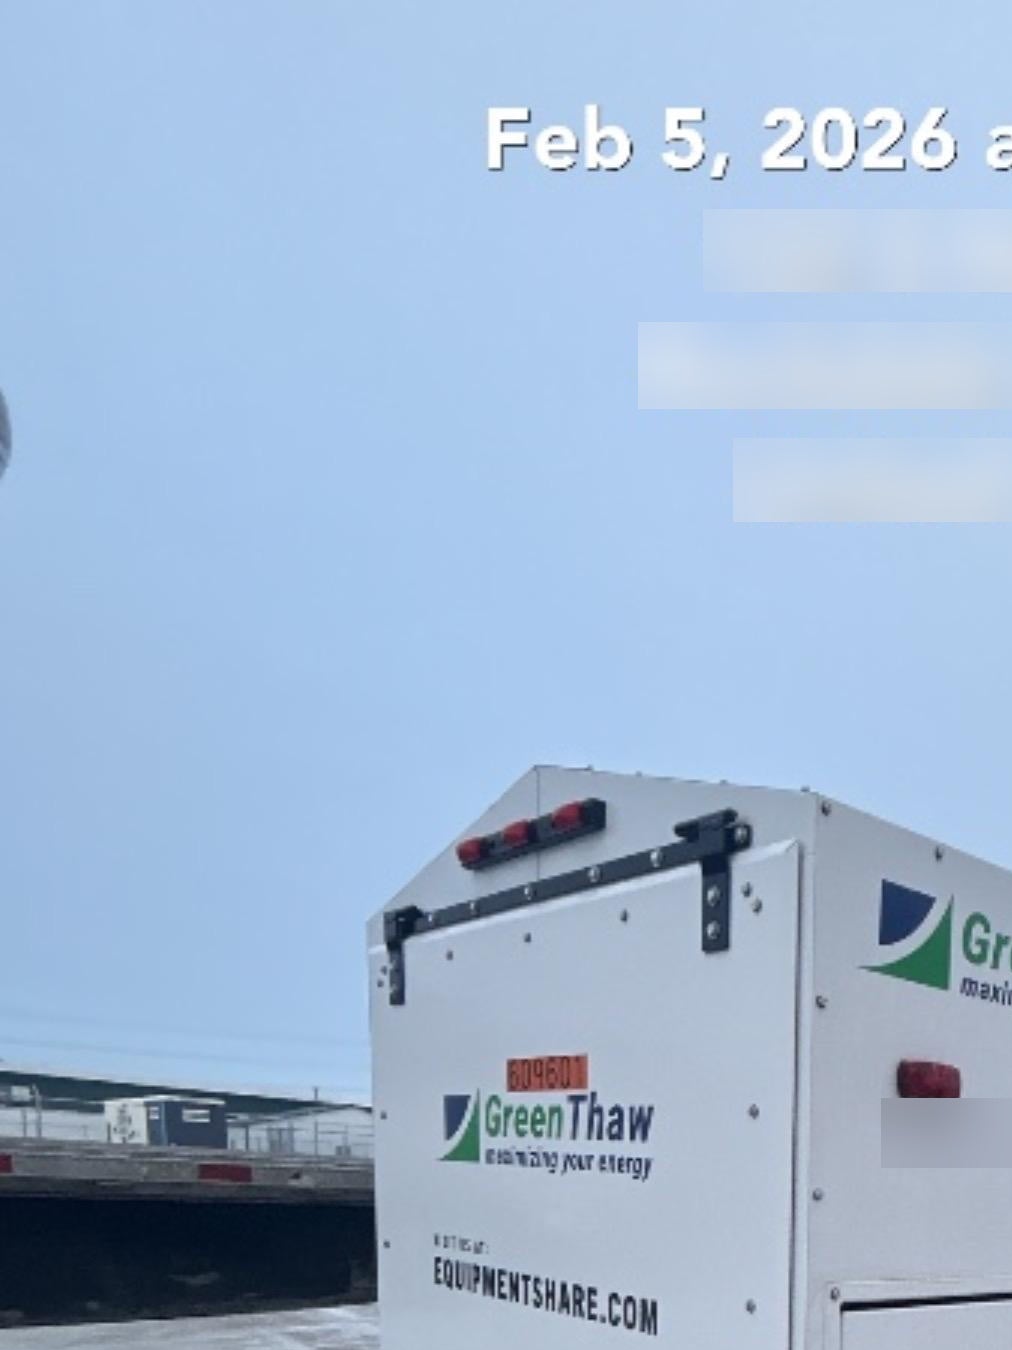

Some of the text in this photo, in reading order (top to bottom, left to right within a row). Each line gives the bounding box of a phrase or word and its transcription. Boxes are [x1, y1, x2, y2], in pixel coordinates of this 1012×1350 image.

[485, 1091, 655, 1143] GreenThaw
[560, 1153, 596, 1176] your
[598, 1154, 653, 1182] energy
[433, 1256, 658, 1336] EQUIPMENTSHARE.COM
